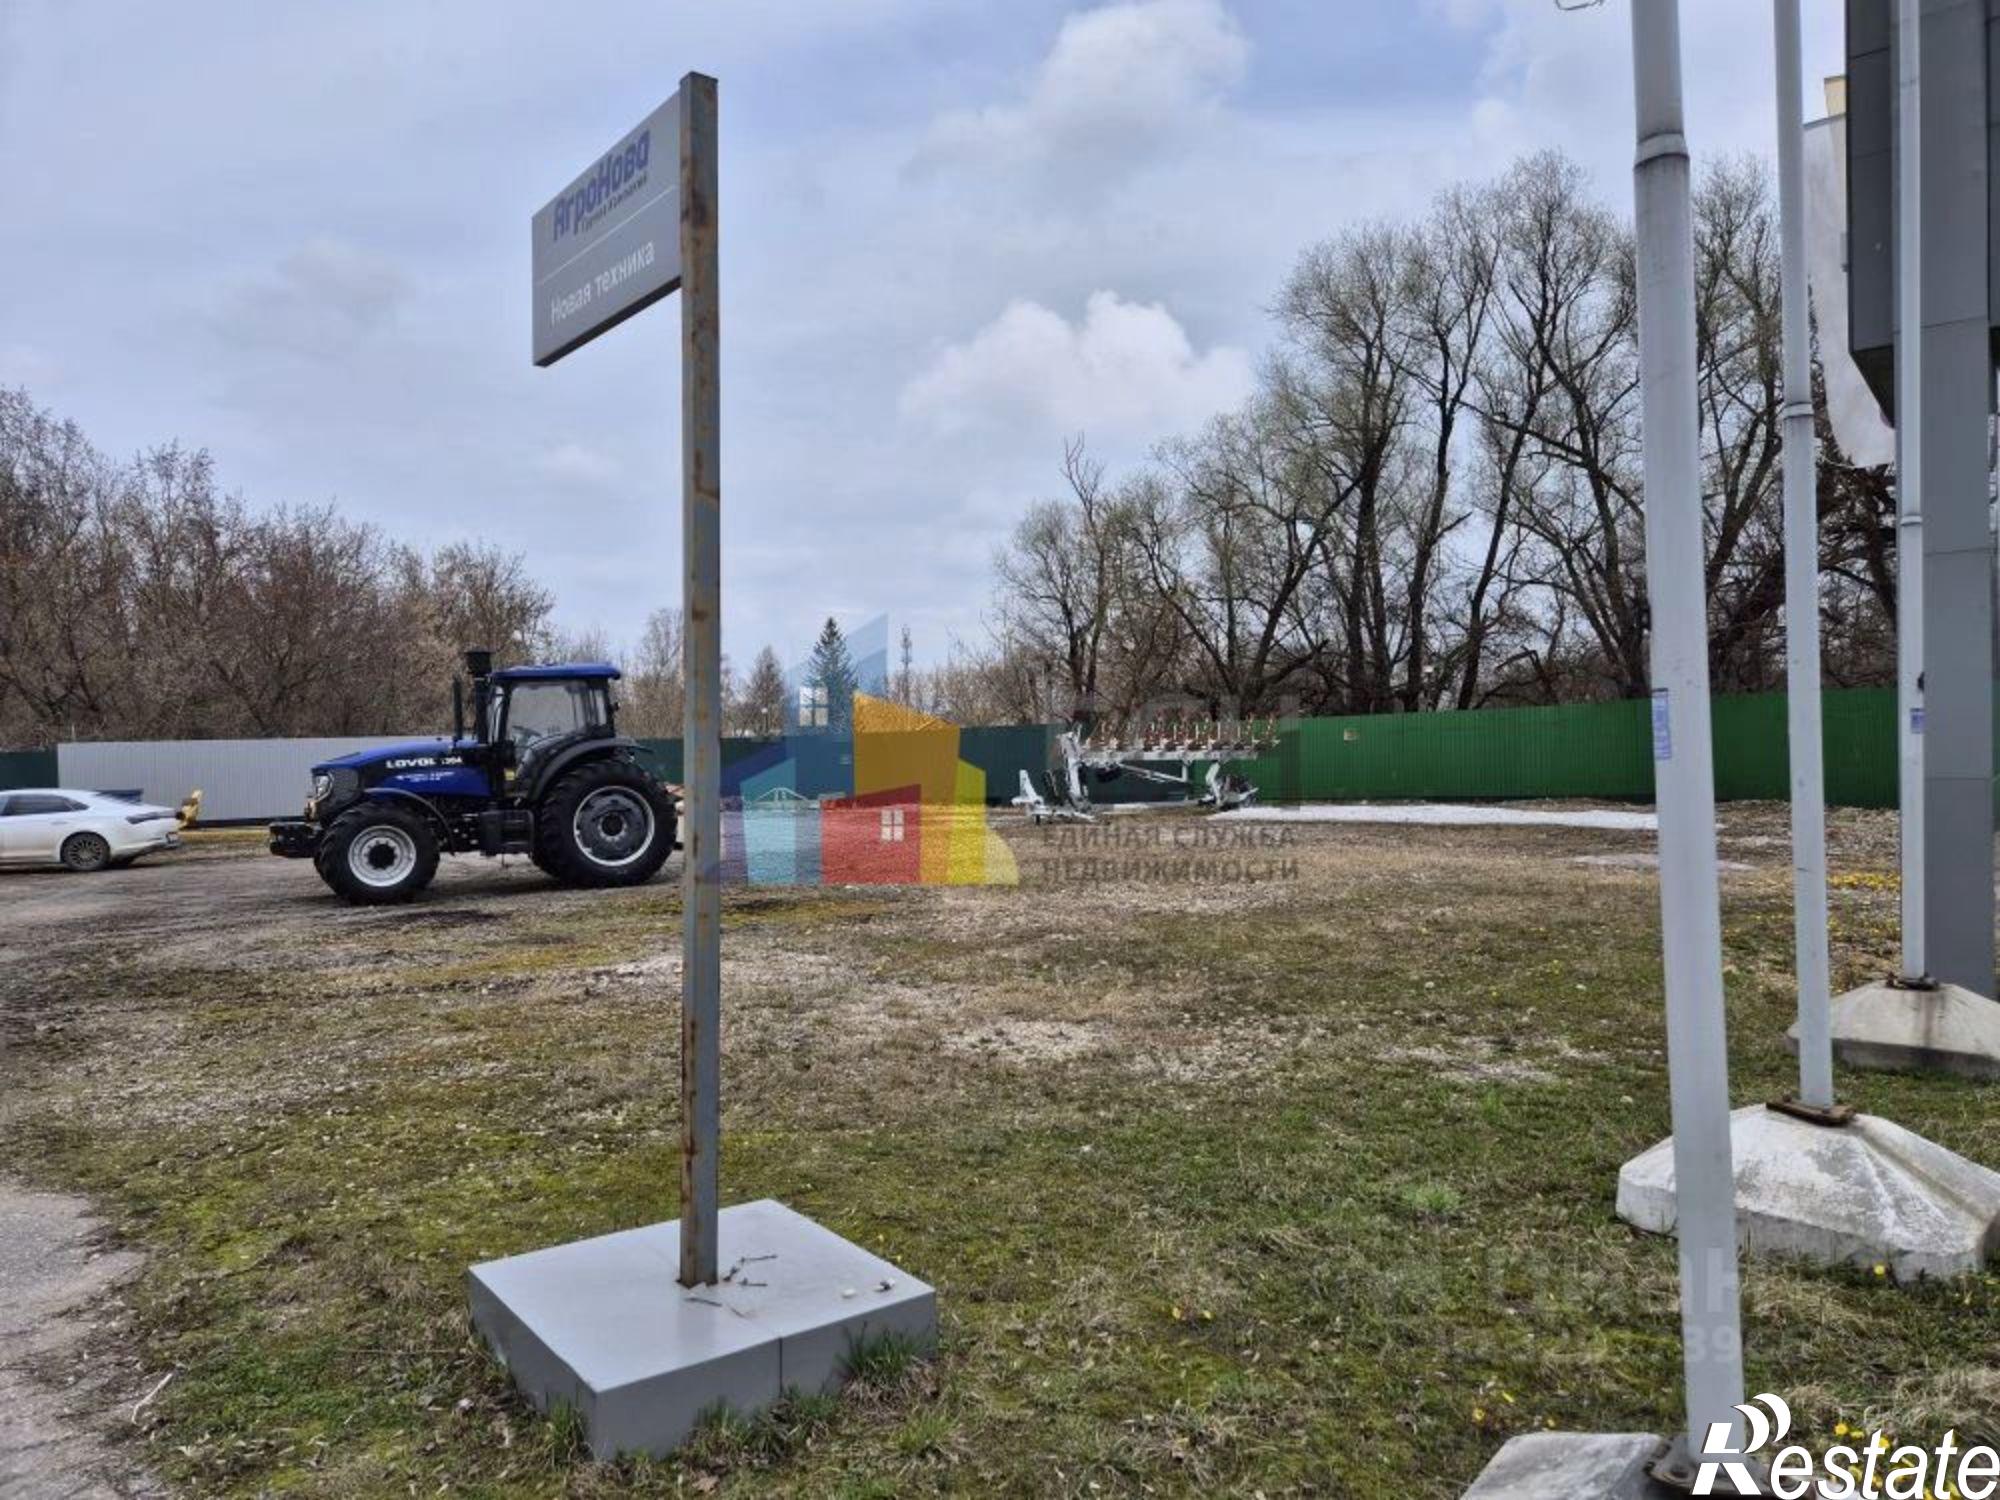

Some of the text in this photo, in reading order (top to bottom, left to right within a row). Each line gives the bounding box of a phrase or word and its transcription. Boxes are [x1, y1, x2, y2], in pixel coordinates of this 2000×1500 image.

[553, 131, 650, 241] АгроНово
[550, 242, 655, 325] Новая техника
[386, 757, 436, 768] LOVOL
